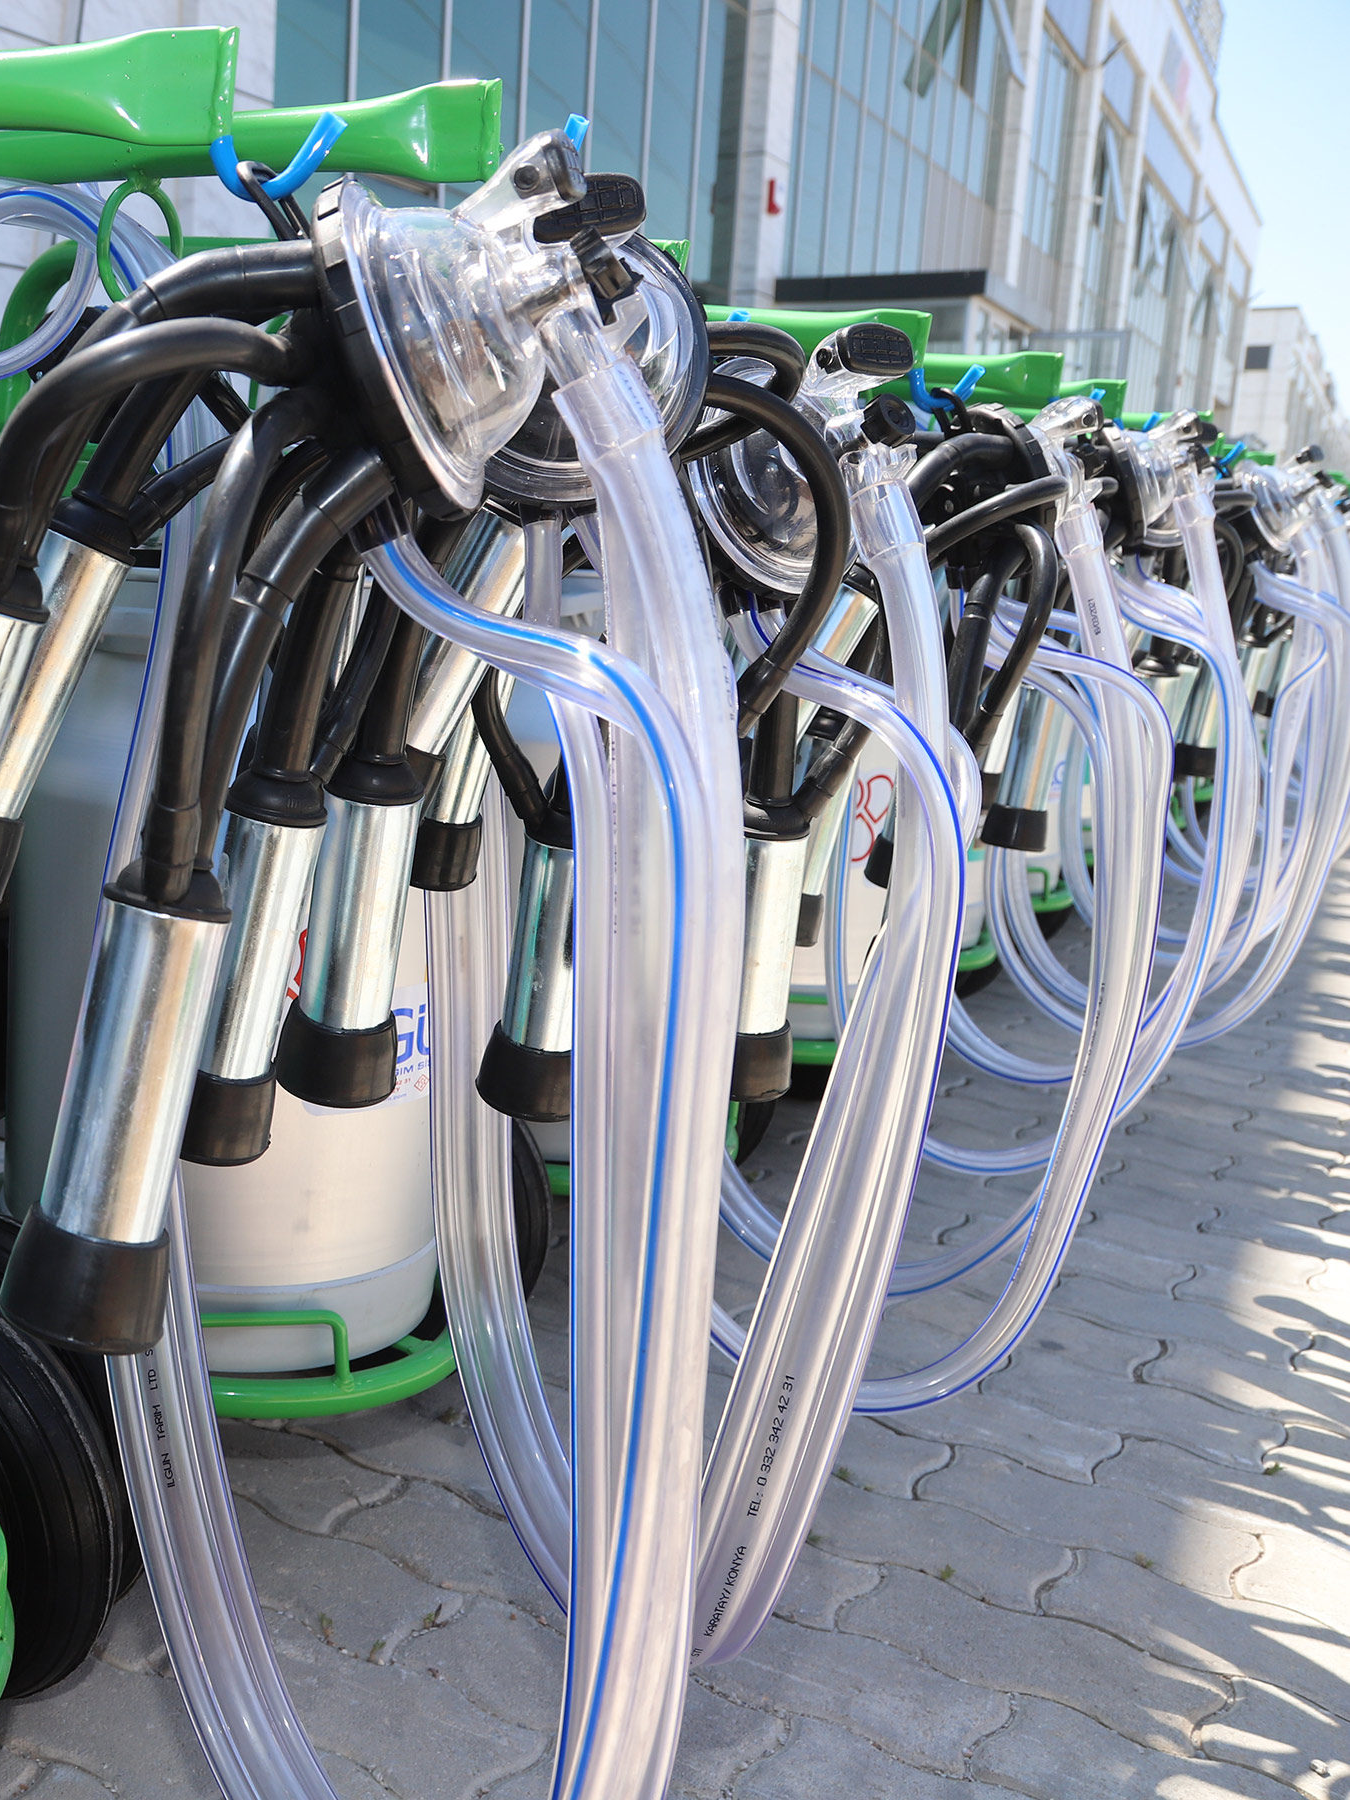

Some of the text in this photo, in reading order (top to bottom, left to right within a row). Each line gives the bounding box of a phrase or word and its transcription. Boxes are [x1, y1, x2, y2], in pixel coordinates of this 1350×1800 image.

[782, 1374, 795, 1391] 31
[144, 1348, 175, 1489] ILGUN TARIM LTD S
[778, 1396, 790, 1415] 42
[769, 1417, 784, 1445] 342
[760, 1447, 777, 1474] 332
[756, 1476, 768, 1487] 0
[726, 1545, 747, 1586] KONYA
